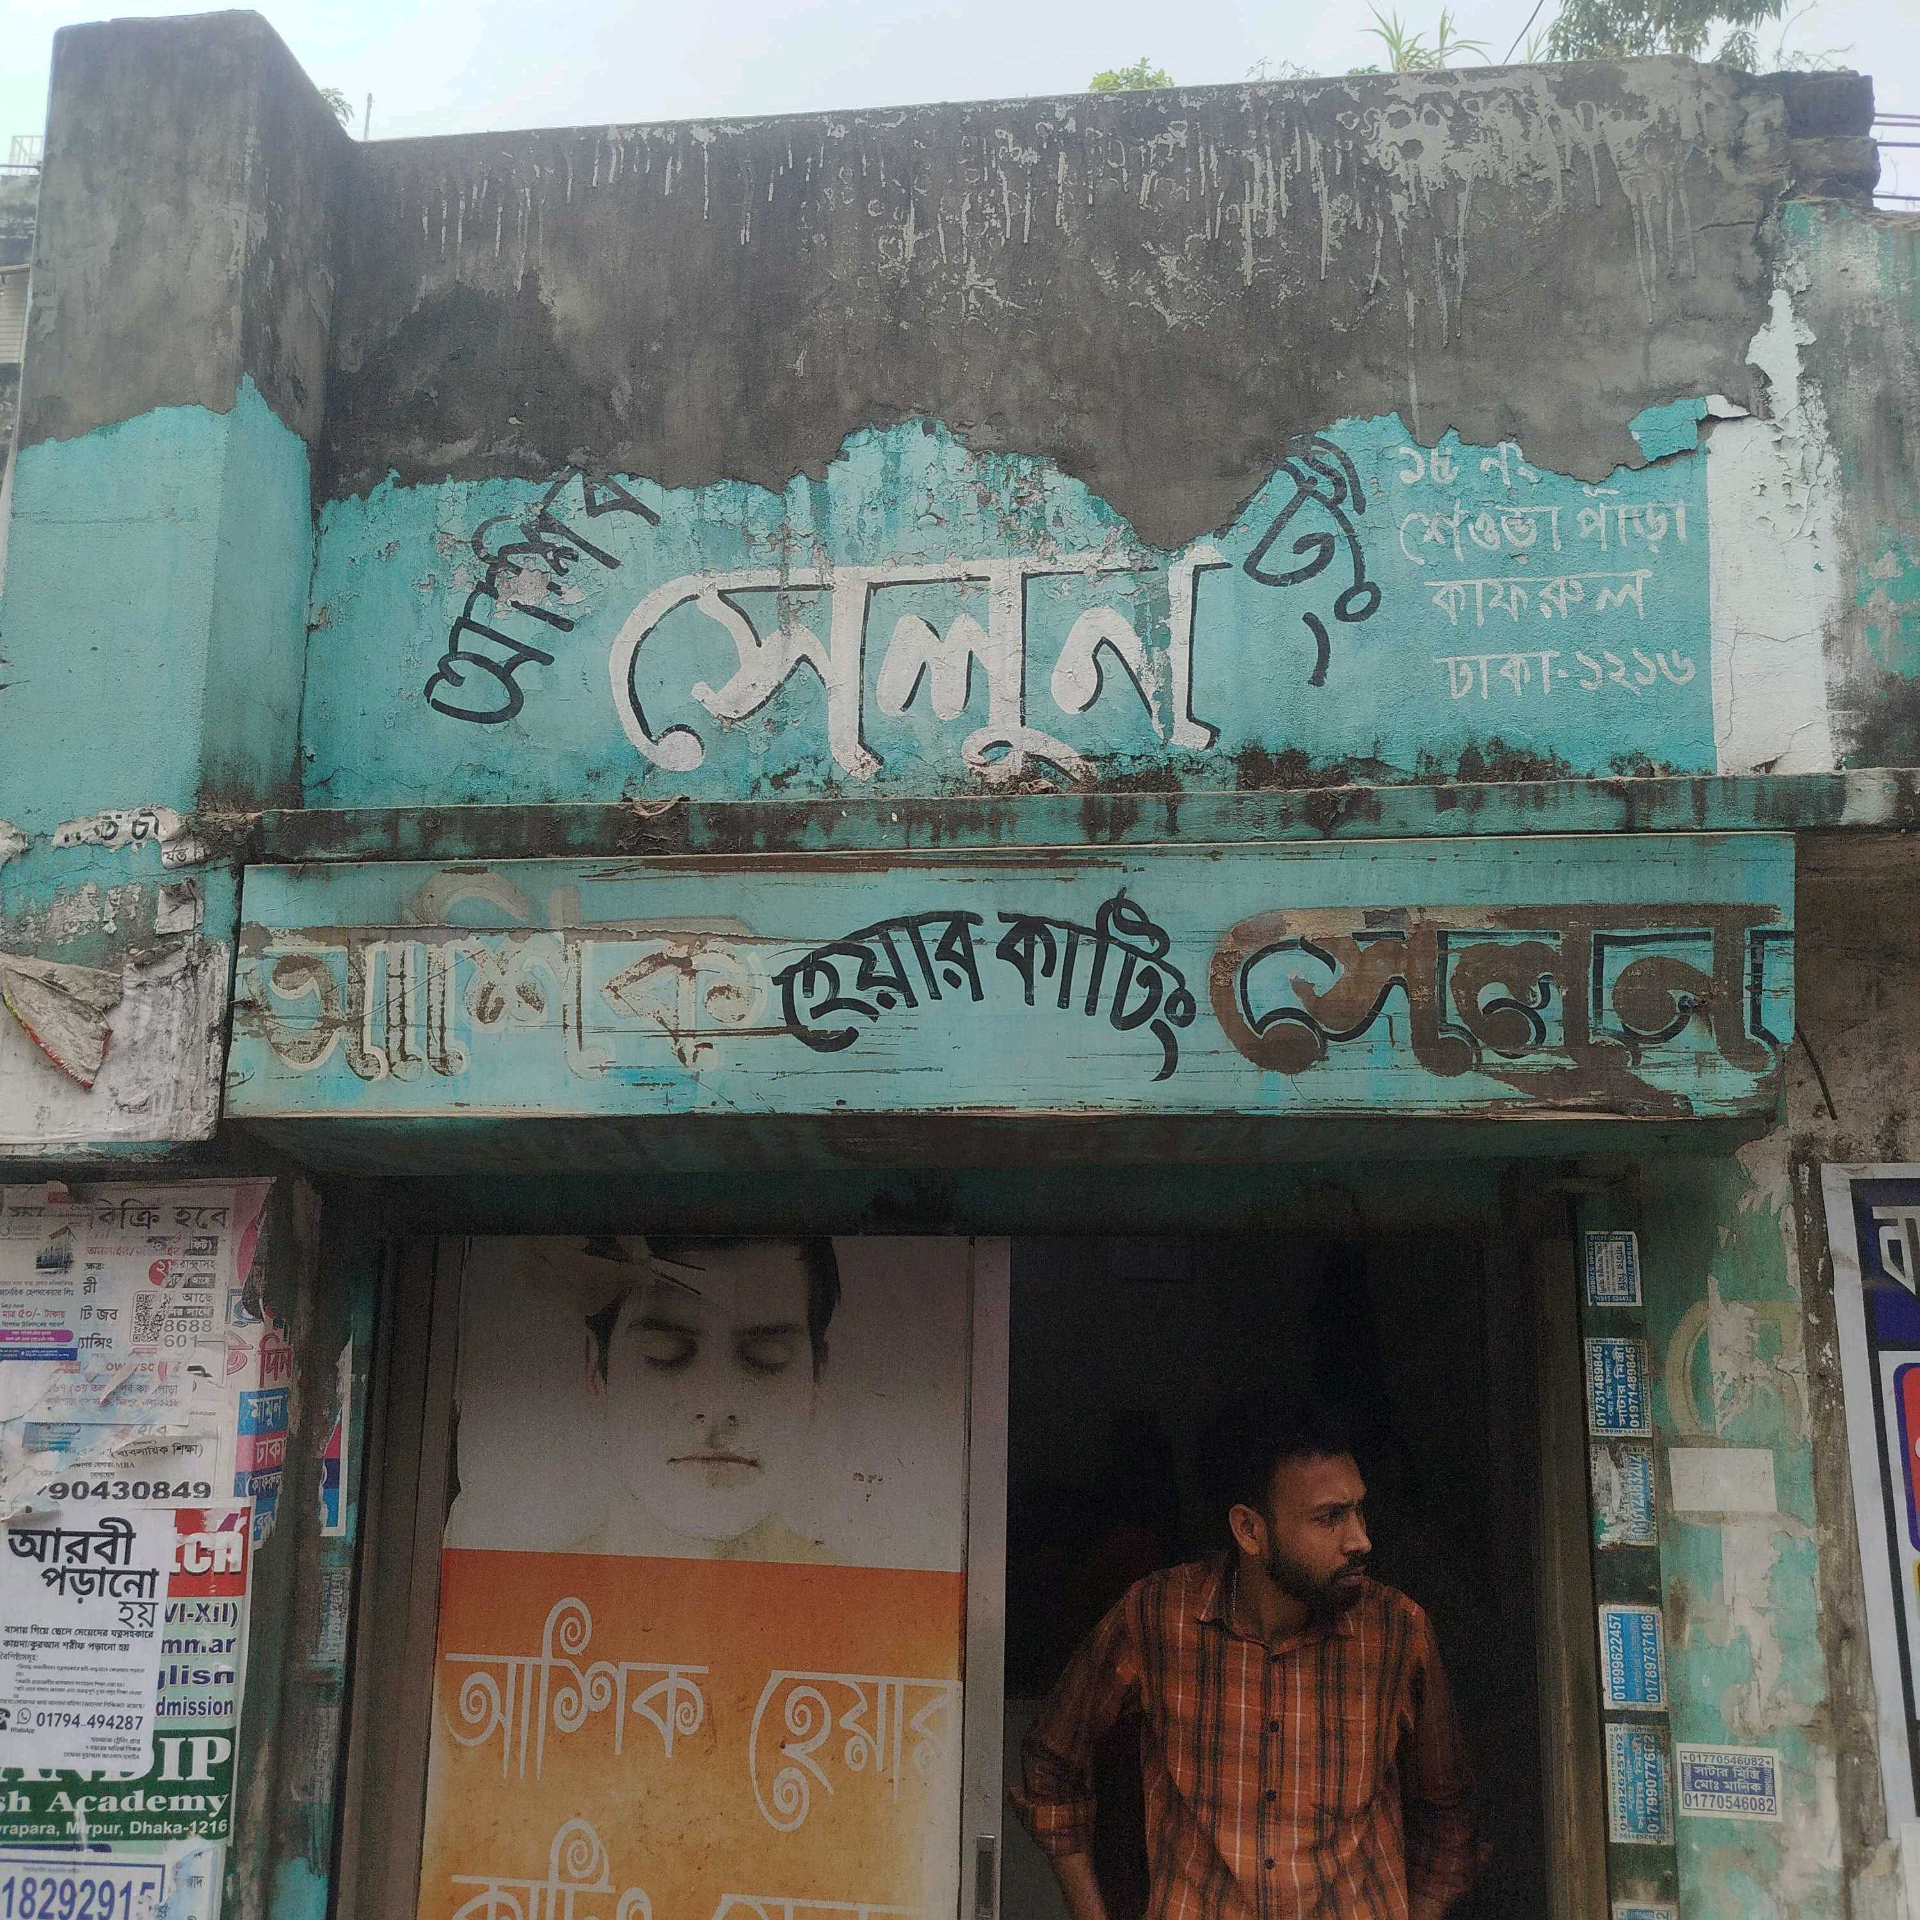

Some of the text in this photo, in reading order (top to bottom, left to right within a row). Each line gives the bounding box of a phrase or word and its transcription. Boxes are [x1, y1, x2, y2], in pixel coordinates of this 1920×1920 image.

[609, 544, 1234, 785] সেলুন
[772, 911, 985, 1051] হেয়ার
[997, 886, 1196, 1082] কাটিং
[1210, 903, 1795, 1116] সেলুন
[173, 1206, 230, 1231] হবে
[182, 1292, 214, 1305] আছে
[1592, 1345, 1607, 1427] 01731489845
[1625, 1346, 1640, 1428] 01971489845
[8, 1517, 136, 1566] আরবী
[41, 1566, 159, 1604] পড়ানো
[118, 1601, 160, 1629] হয়
[117, 1642, 131, 1653] হয়
[1608, 1614, 1626, 1701] 01999622457
[1641, 1614, 1659, 1702] 01789737186
[446, 1597, 709, 1782] আশিক
[750, 1670, 962, 1832] হেয়ার
[1689, 1753, 1764, 1767] 01770546082
[1693, 1765, 1728, 1777] সাটার
[1616, 1733, 1627, 1831] 01982625192
[1694, 1779, 1719, 1790] মোঃ
[1723, 1779, 1761, 1793] মানিক
[45, 1790, 229, 1818] Academy
[1684, 1793, 1774, 1812] 01770546082
[130, 1818, 228, 1835] Dhaka-1216
